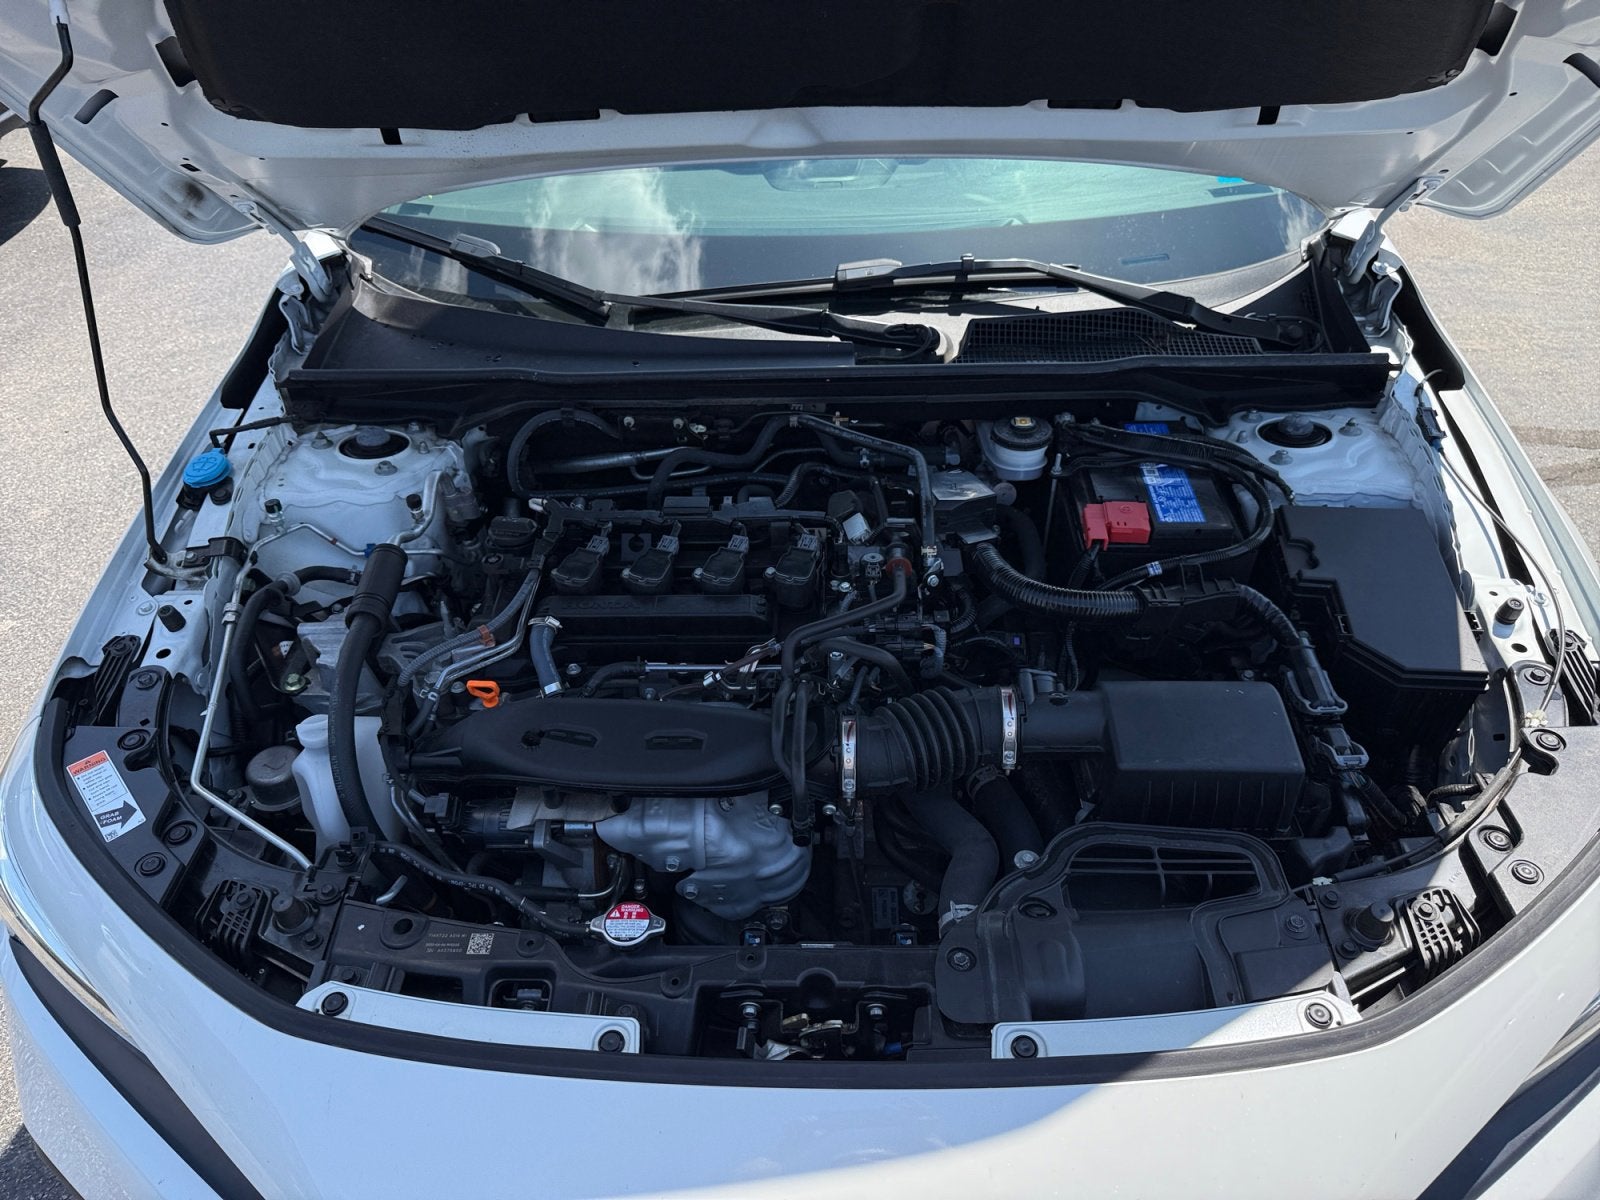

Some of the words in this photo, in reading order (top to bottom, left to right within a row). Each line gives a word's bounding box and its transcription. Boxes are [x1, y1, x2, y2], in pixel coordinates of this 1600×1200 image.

[561, 599, 640, 609] HONDA
[73, 757, 107, 774] WARNING
[100, 811, 120, 820] GRAB
